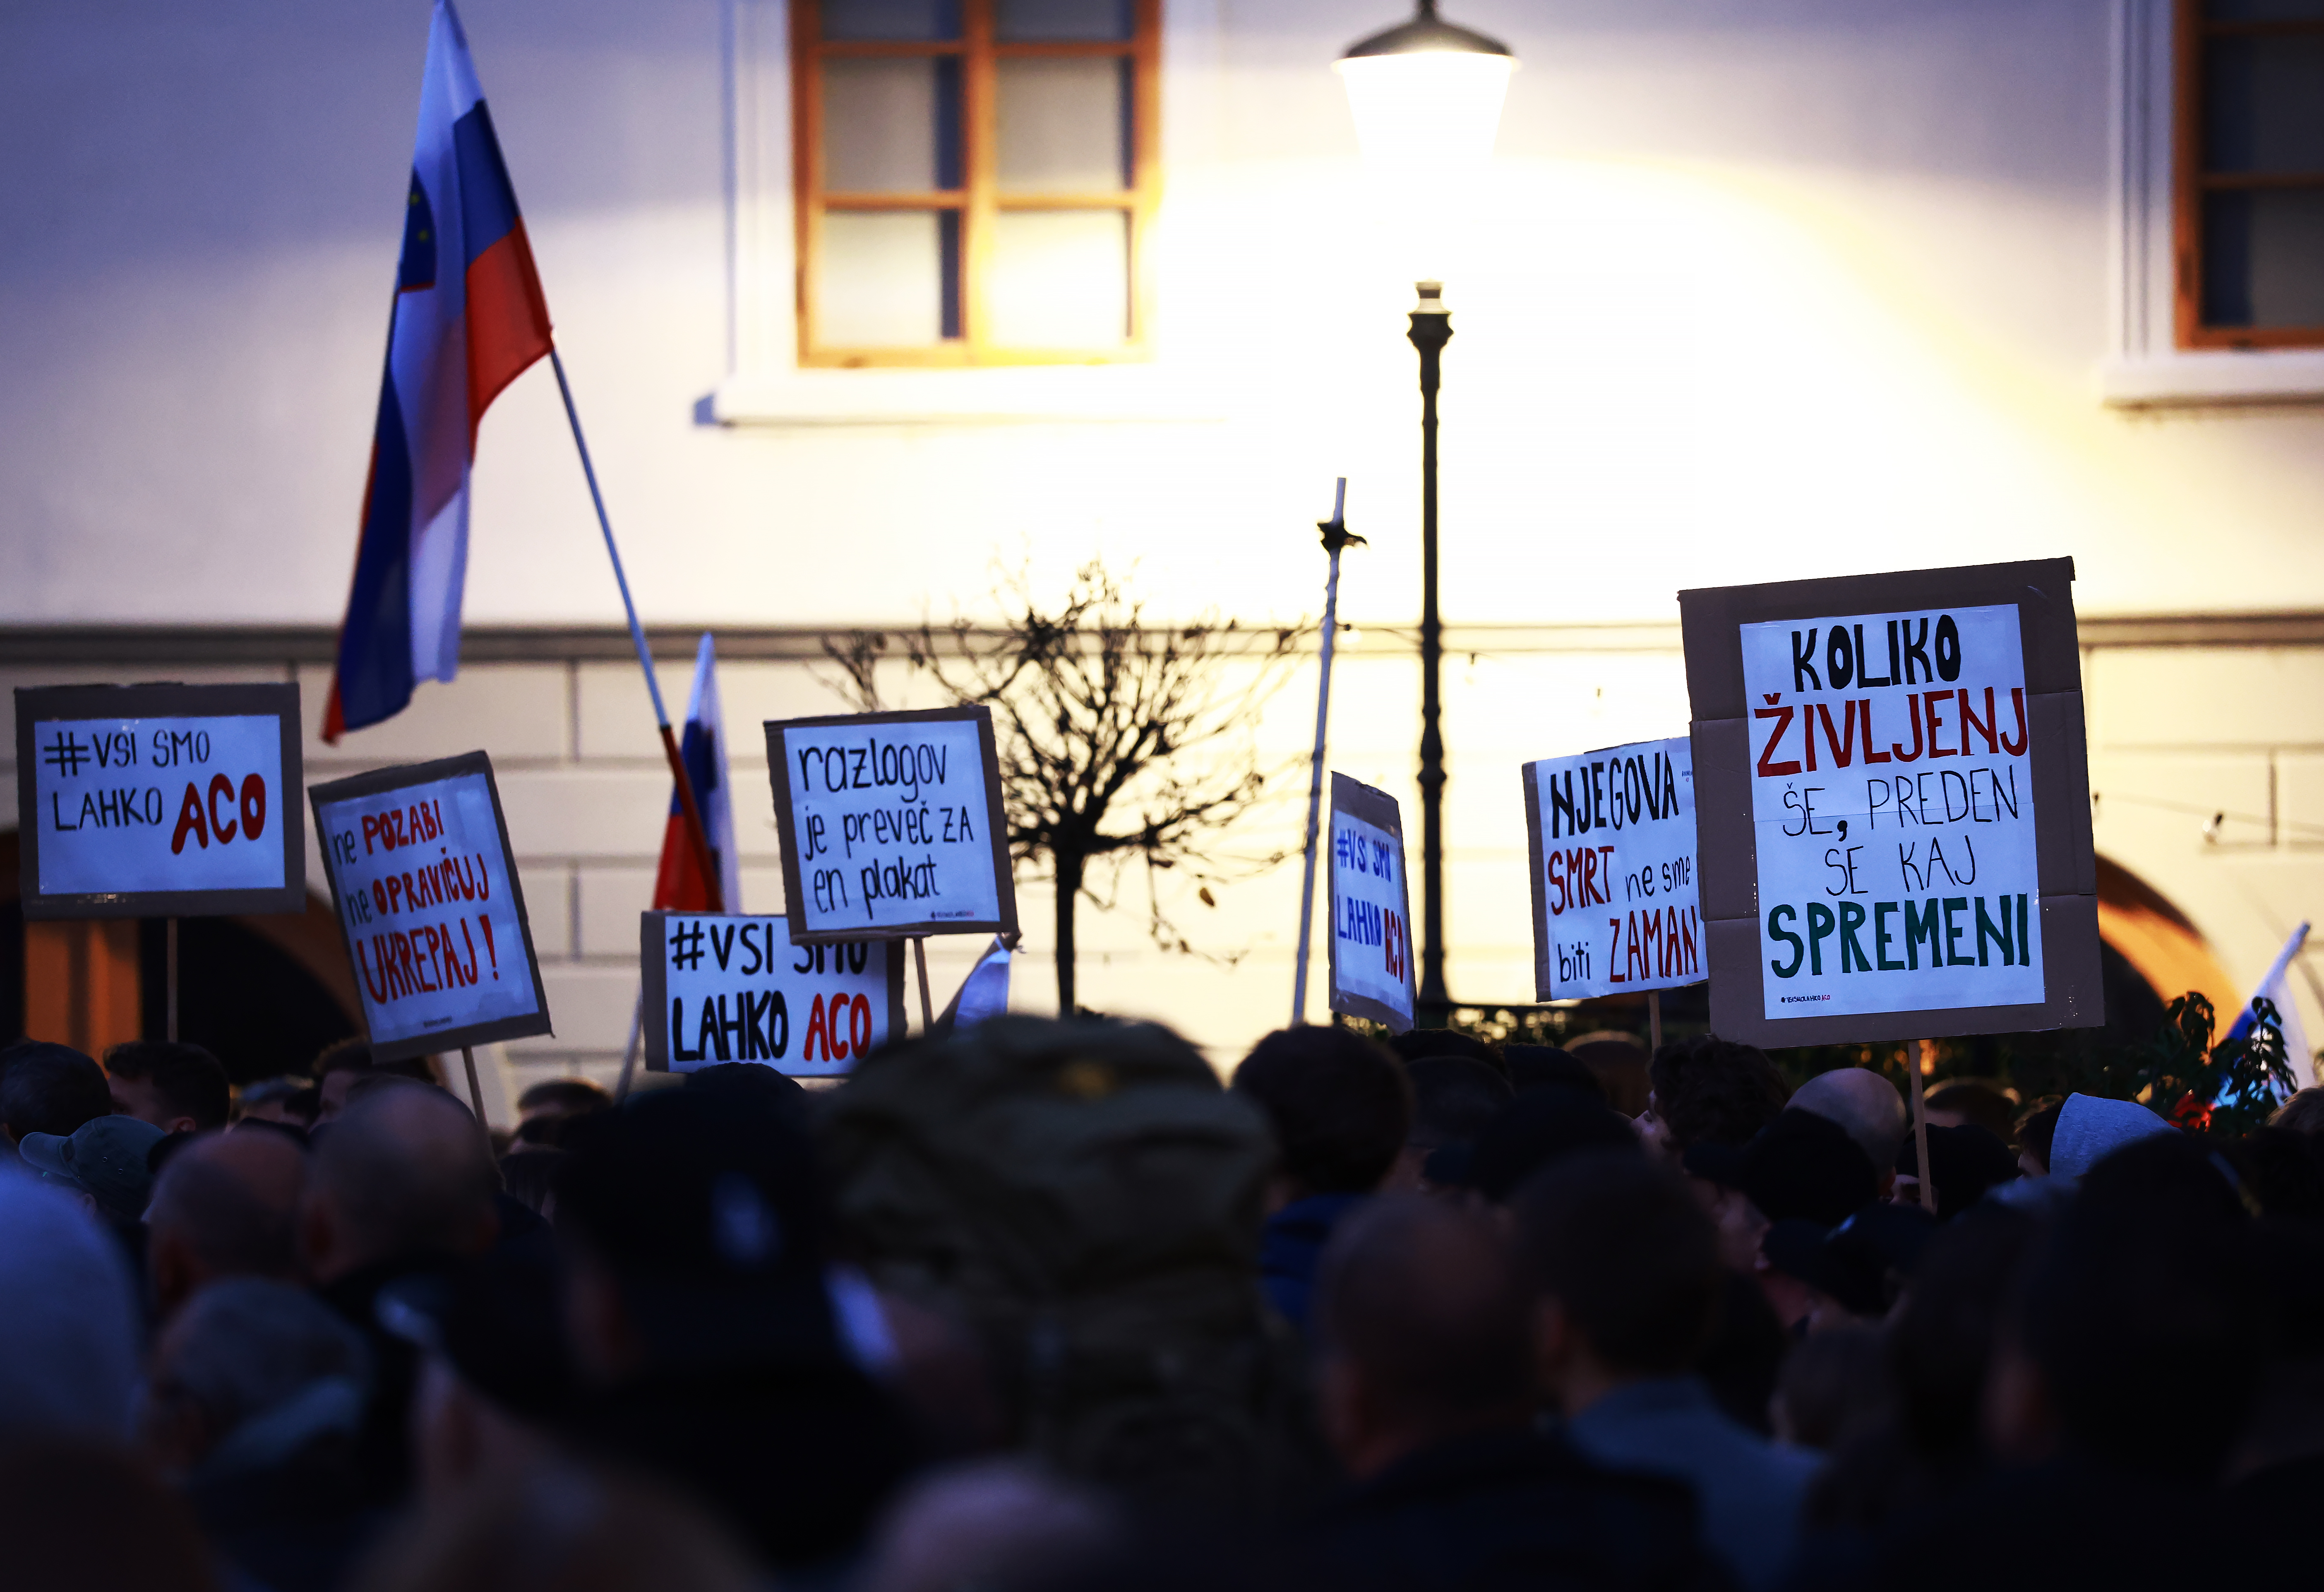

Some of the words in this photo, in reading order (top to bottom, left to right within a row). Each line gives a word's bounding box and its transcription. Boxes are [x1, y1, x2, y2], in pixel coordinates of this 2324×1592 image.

[1791, 613, 1962, 693] KOLIKO
[43, 731, 137, 778] #VSI
[152, 730, 210, 768] SMO
[1753, 686, 2029, 778] ŽIVLJENJ
[798, 738, 947, 803] razlogov
[1550, 750, 1679, 839] NJEGOVA
[1866, 764, 2019, 830] PREDEN
[51, 787, 163, 832] LAHKO
[170, 773, 266, 856] ACO
[333, 830, 357, 866] ne
[361, 799, 444, 855] POZABI
[804, 806, 828, 862] je
[842, 801, 933, 858] preveč
[939, 806, 974, 843] ZA
[346, 888, 372, 926] ne
[373, 846, 490, 915] OPRAVIČUJ
[814, 868, 848, 914] en
[860, 854, 941, 920] plakat
[1548, 845, 1615, 916] SMRT
[1625, 865, 1655, 902] ne
[1662, 856, 1690, 892] sme
[1825, 845, 1868, 896] SE
[1899, 835, 1976, 892] KAJ
[670, 921, 773, 975] #VSI
[1557, 941, 1590, 983] biti
[1609, 905, 1699, 983] ZAMAN
[1768, 892, 2030, 979] SPREMENI
[672, 990, 790, 1062] LAHKO
[803, 992, 873, 1062] ACO
